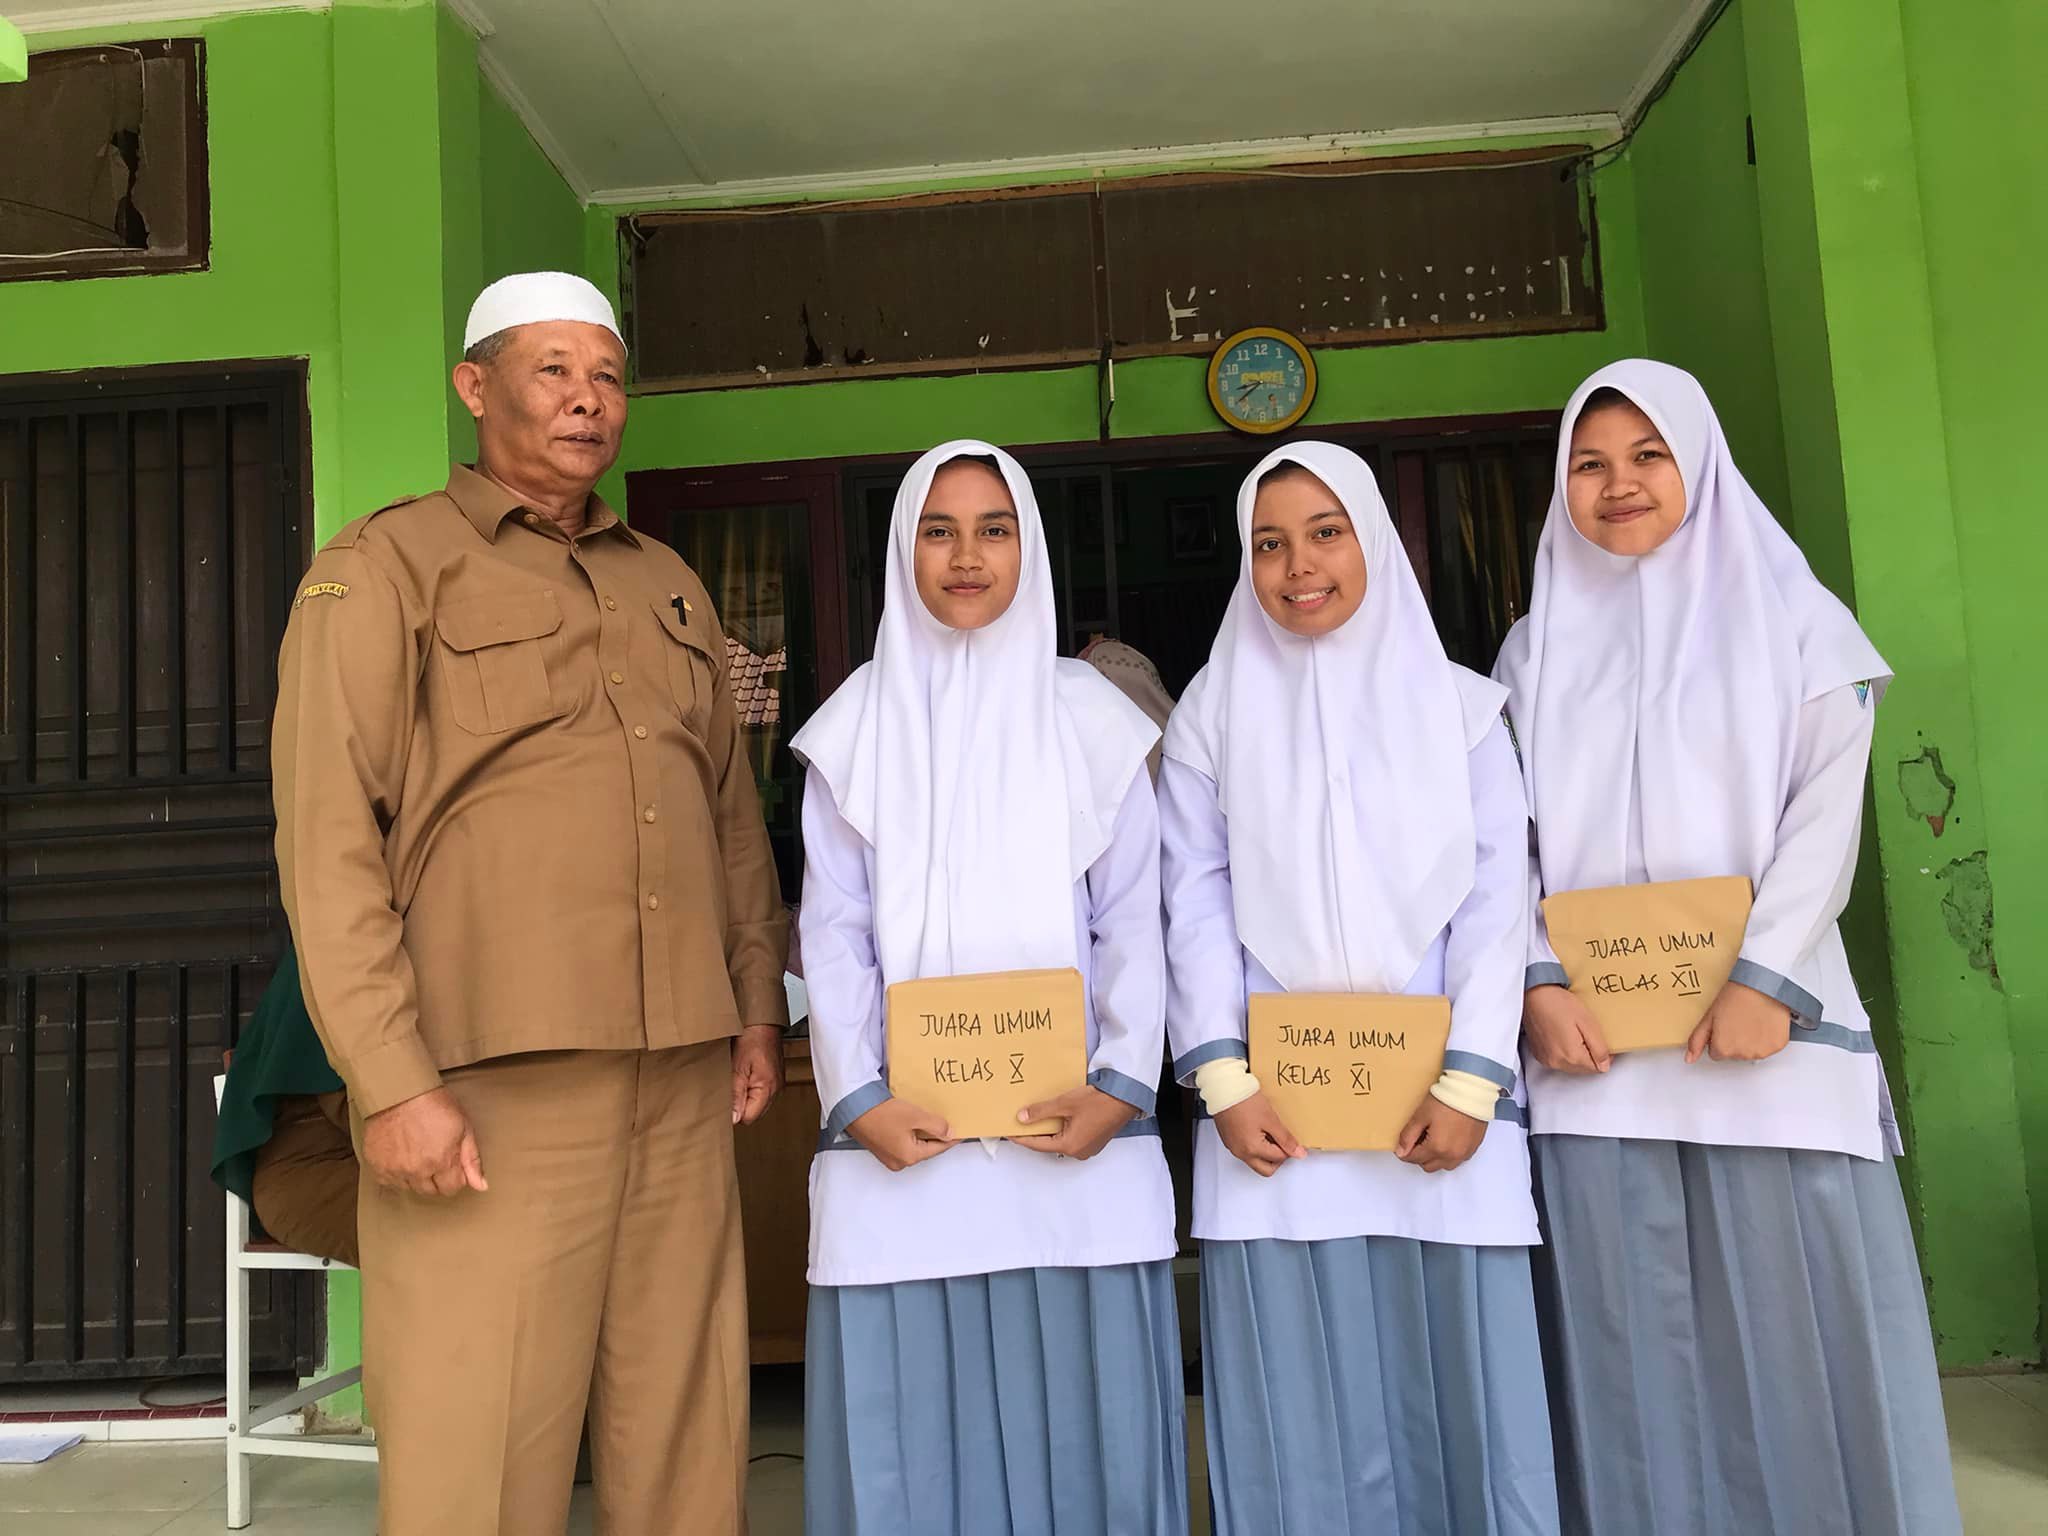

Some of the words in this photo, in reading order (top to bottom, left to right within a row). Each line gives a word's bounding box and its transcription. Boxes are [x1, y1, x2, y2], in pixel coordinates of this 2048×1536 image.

[1236, 350, 1250, 361] 11
[1254, 344, 1268, 356] 12
[1275, 348, 1283, 359] 1
[1225, 364, 1239, 376] 10
[1287, 360, 1296, 372] 2
[1294, 376, 1301, 387] 3
[1585, 937, 1648, 959] JUARA
[1659, 931, 1716, 953] UMUM
[1592, 973, 1660, 996] KELAS
[1671, 963, 1702, 997] XII
[920, 1012, 982, 1038] JUARA
[994, 1008, 1053, 1035] UMUM
[1277, 1024, 1336, 1047] JUARA
[1349, 1029, 1406, 1051] UMUM
[933, 1057, 994, 1084] KELAS
[1009, 1053, 1025, 1085] X
[1277, 1060, 1332, 1087] KELAS
[1349, 1062, 1372, 1096] XI
